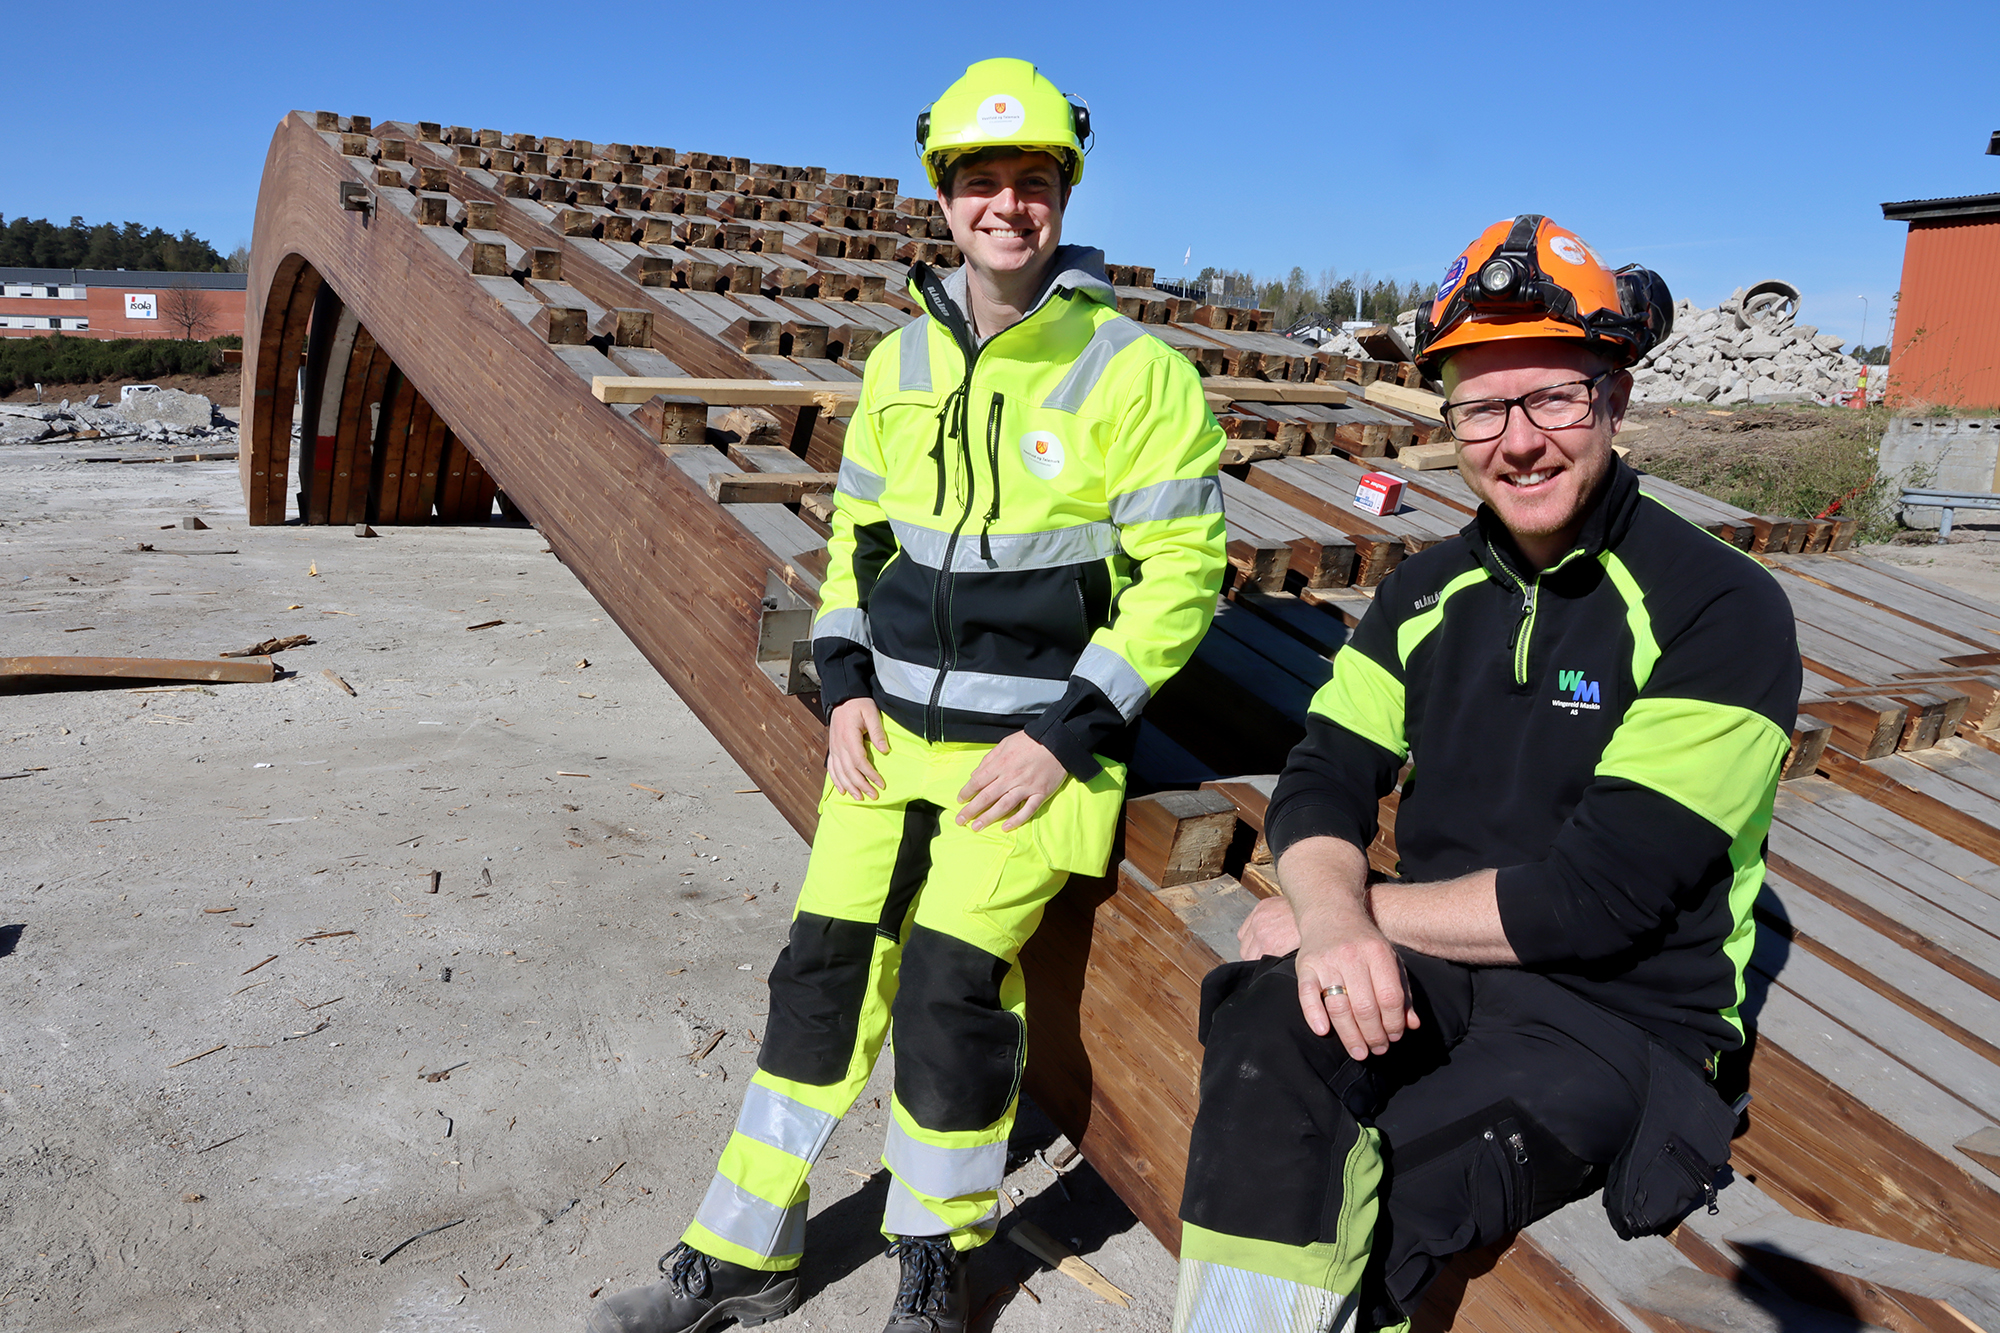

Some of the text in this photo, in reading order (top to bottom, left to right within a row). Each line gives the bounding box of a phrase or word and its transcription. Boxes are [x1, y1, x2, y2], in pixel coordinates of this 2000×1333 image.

[130, 297, 152, 310] isola
[1558, 670, 1600, 703] WM
[1580, 702, 1600, 710] Maskin
